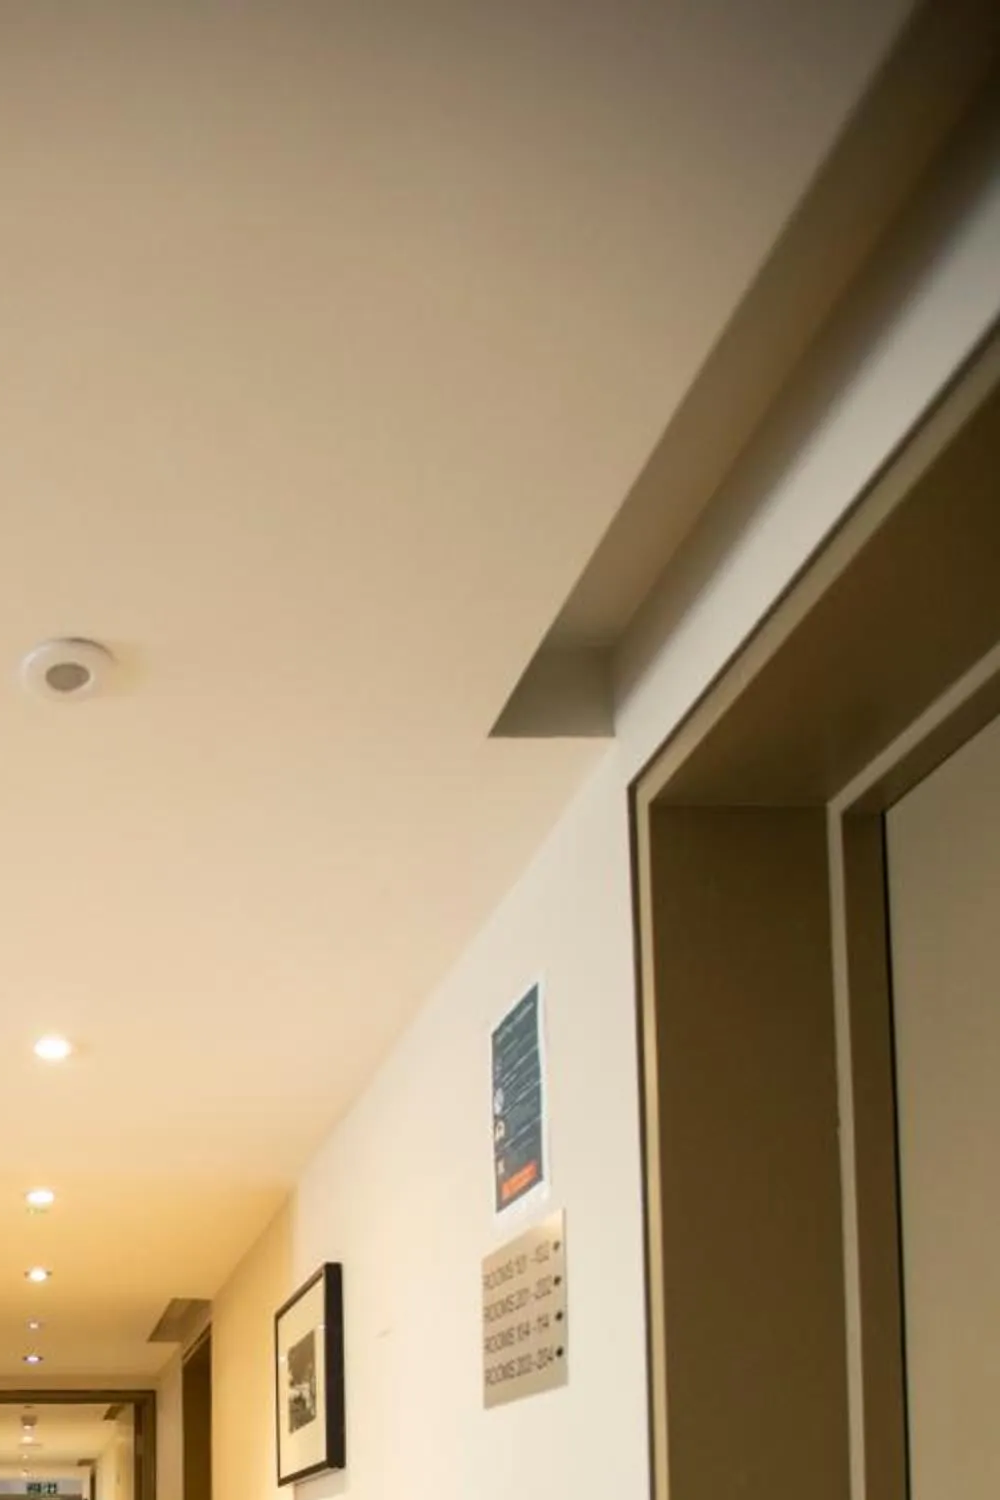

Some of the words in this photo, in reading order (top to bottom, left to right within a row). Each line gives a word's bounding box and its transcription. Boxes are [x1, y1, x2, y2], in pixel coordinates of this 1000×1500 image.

[483, 1259, 514, 1290] ROOMS
[483, 1293, 514, 1322] ROOMS
[484, 1326, 514, 1353] ROOMS
[484, 1358, 515, 1386] ROOMS
